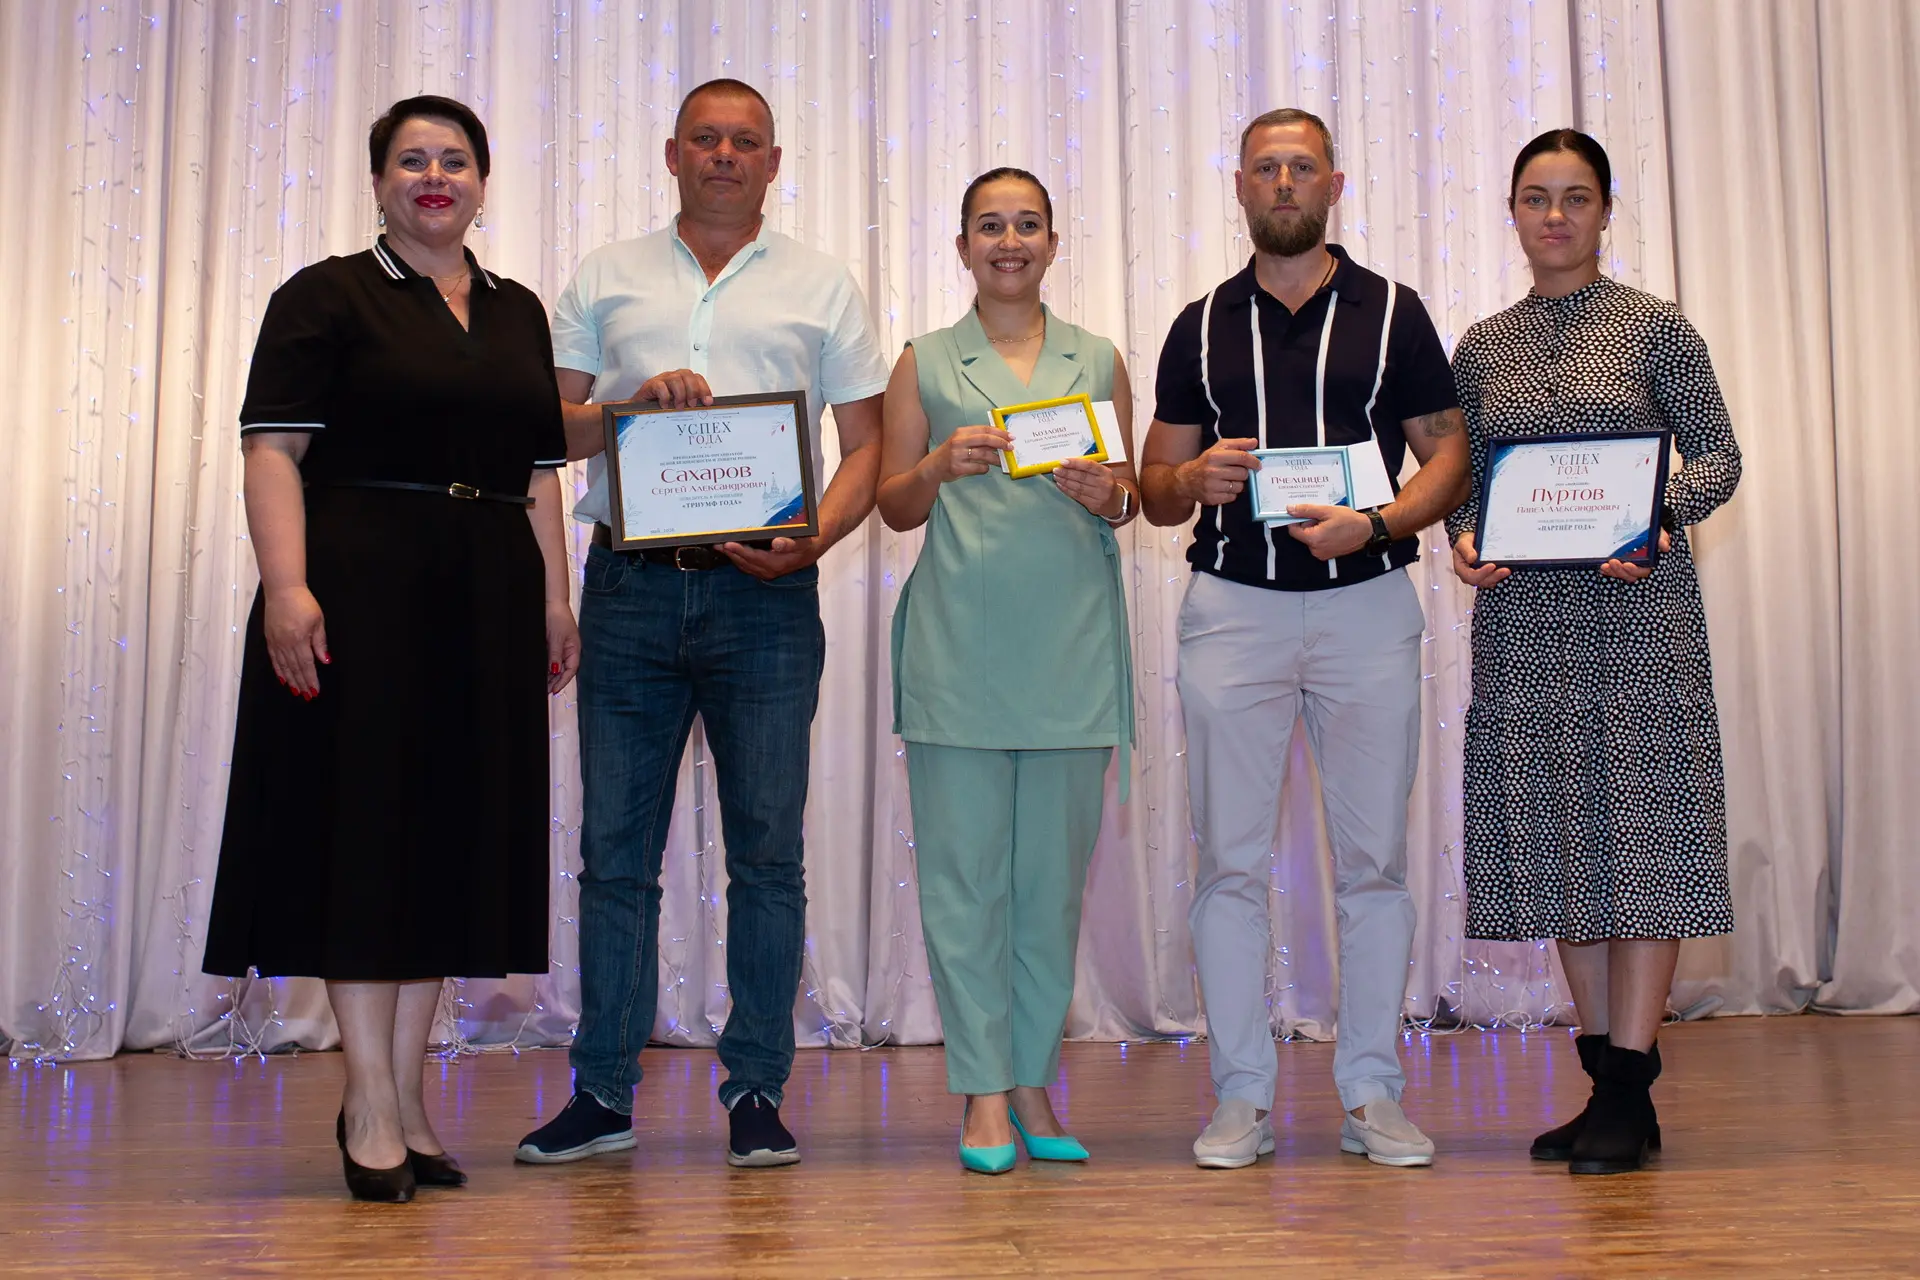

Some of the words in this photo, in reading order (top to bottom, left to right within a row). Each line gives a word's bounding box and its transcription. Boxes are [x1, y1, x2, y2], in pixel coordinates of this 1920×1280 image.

[1031, 410, 1058, 420] УСПЕХ
[677, 421, 732, 436] УСПЕХ
[688, 434, 723, 445] ГОДА
[1285, 458, 1313, 466] УСПЕХ
[1550, 453, 1600, 467] УСПЕХ
[661, 465, 752, 484] Сахаров
[1557, 465, 1589, 476] ГОДА
[1532, 488, 1605, 505] Пуртов
